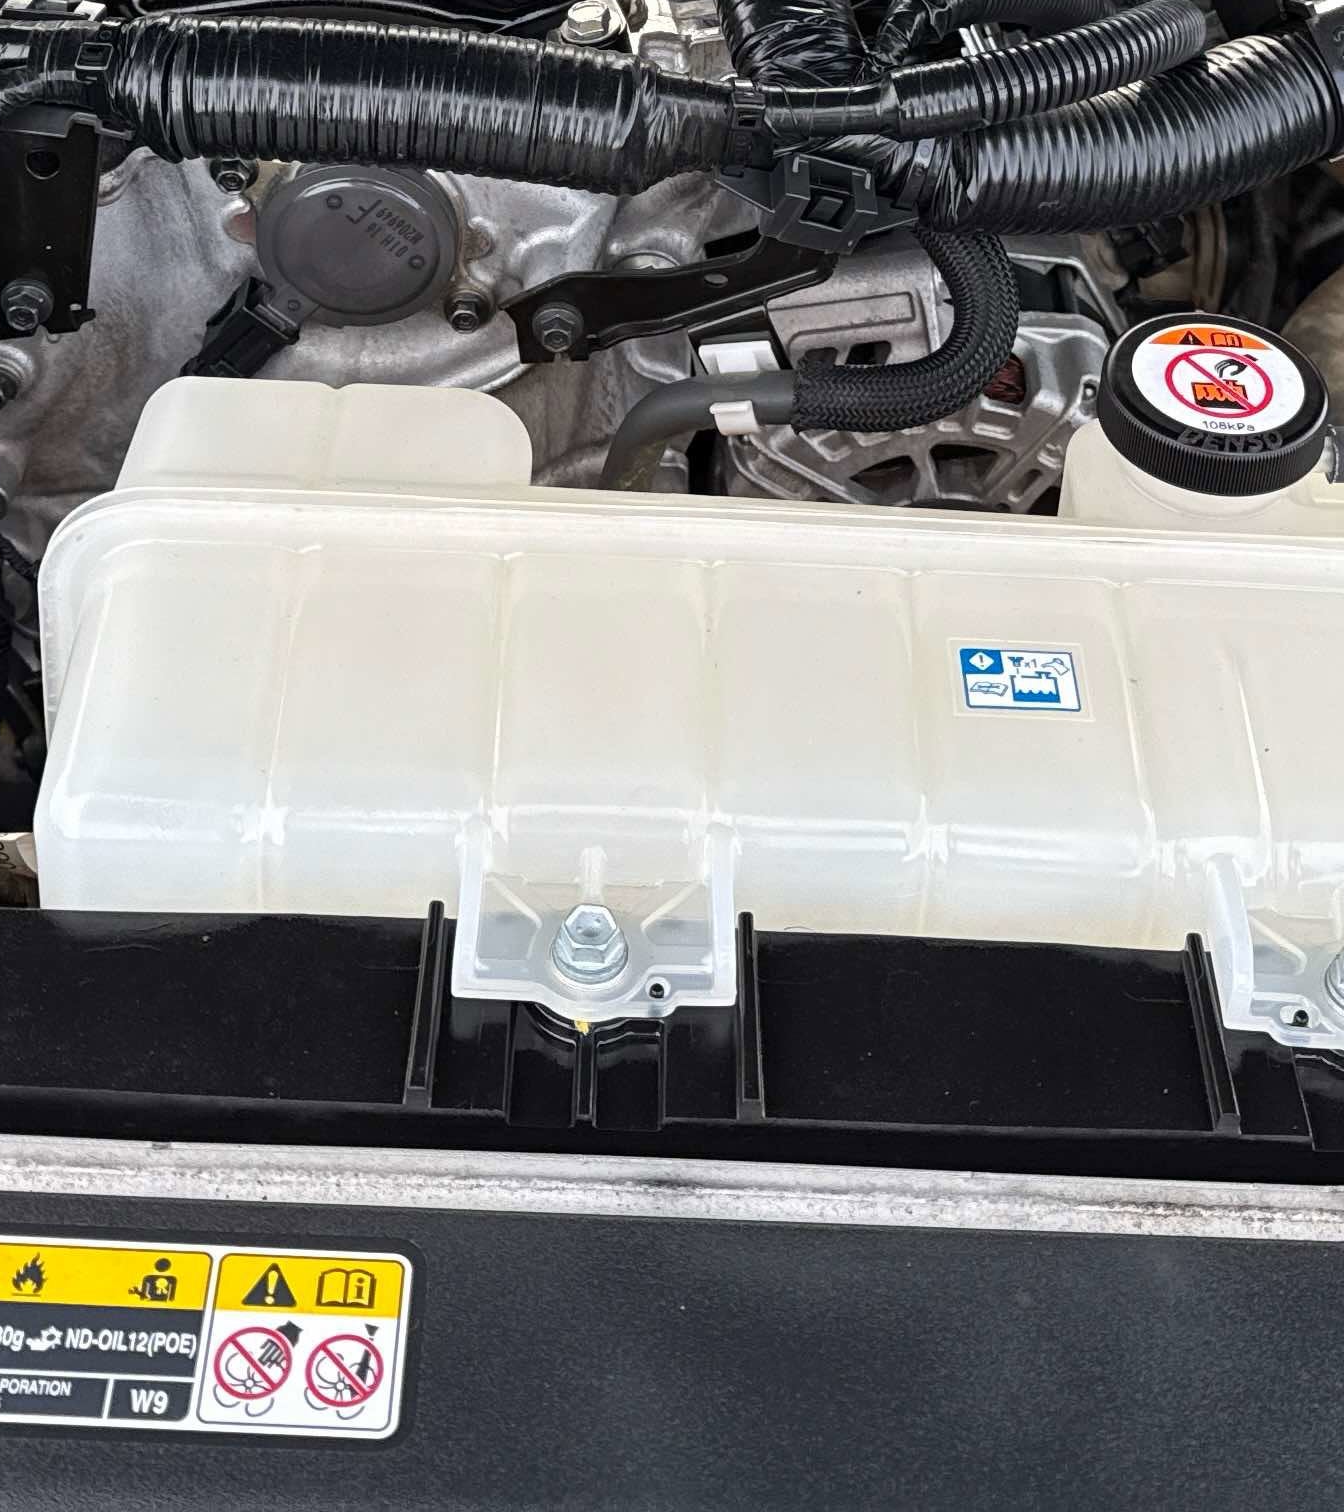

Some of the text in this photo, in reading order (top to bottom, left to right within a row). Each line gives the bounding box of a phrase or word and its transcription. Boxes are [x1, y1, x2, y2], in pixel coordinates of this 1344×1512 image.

[1202, 420, 1256, 432] 108kPa
[1176, 428, 1284, 454] DENSO
[64, 1327, 197, 1360] ND-OIL12(POE)
[130, 1388, 169, 1415] W9
